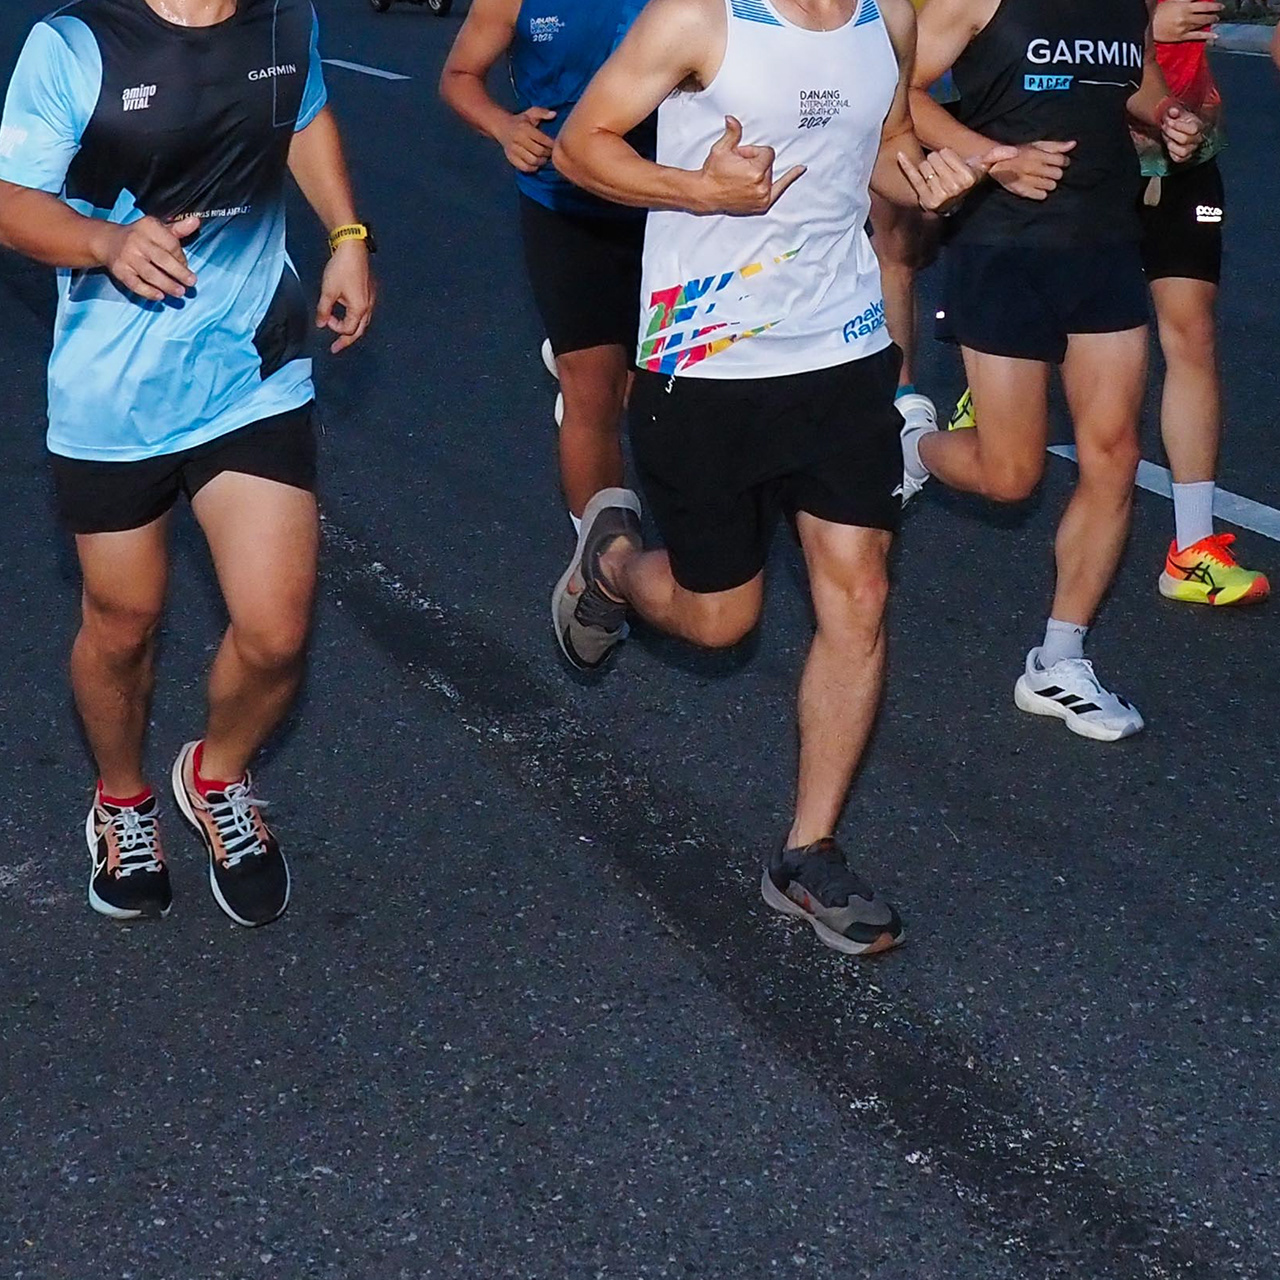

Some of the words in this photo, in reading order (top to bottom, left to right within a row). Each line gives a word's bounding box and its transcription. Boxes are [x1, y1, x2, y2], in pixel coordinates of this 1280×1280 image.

[1026, 38, 1142, 68] GARMIN
[248, 64, 296, 81] GARMIN
[122, 84, 157, 100] amino
[800, 90, 840, 100] DANANG
[123, 98, 151, 111] VITAL
[800, 108, 840, 116] MARATHON
[798, 117, 831, 129] 2024
